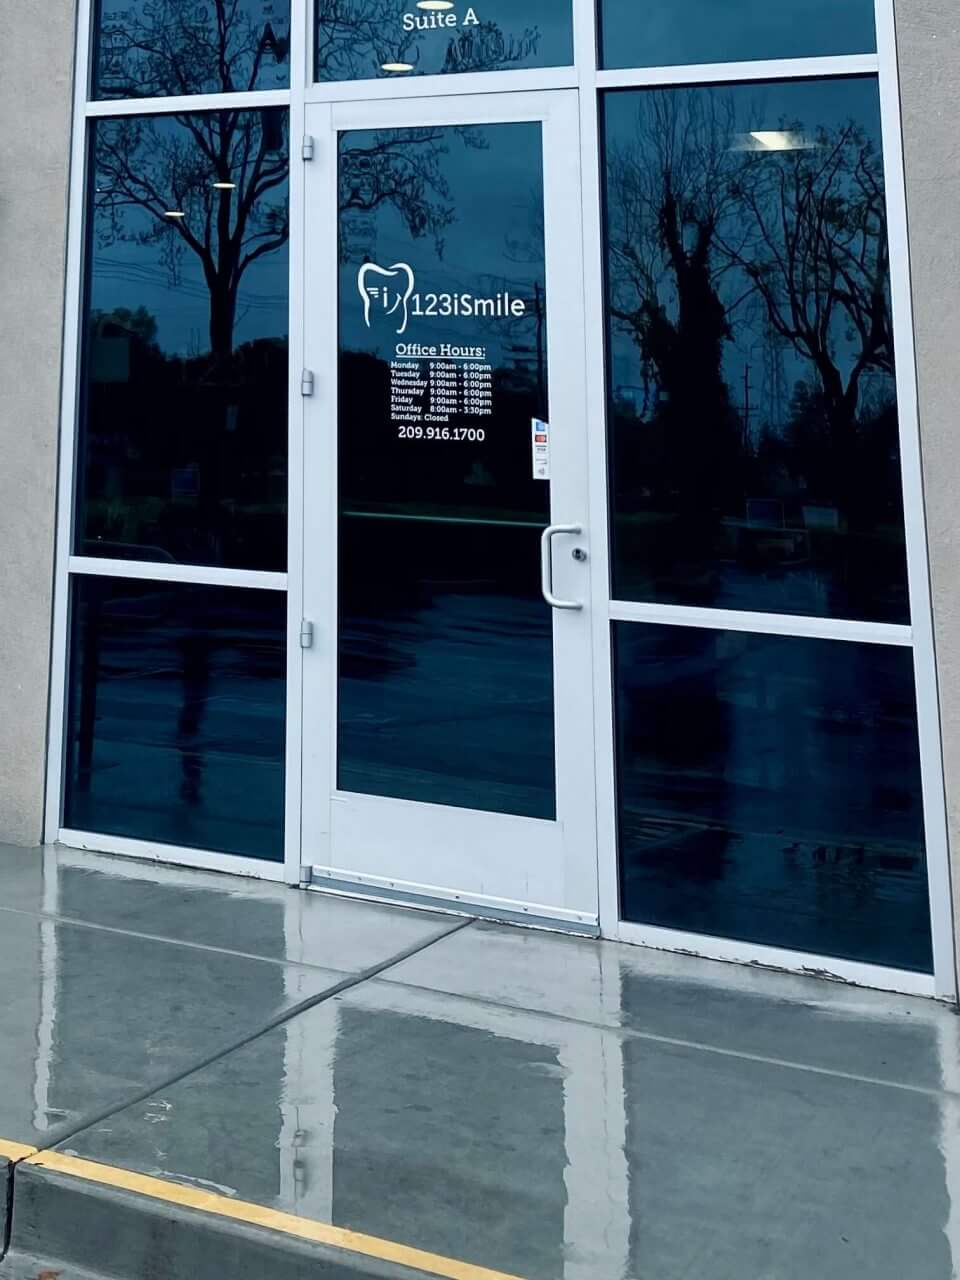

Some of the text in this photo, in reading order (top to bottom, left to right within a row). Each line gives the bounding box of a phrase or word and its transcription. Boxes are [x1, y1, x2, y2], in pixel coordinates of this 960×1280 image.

[403, 7, 480, 31] Suite A
[411, 292, 526, 317] 123iSmile
[396, 343, 486, 357] Office Hours:
[390, 361, 420, 371] Monday
[390, 370, 420, 379] Tuesday
[390, 378, 428, 388] Wednesday
[390, 387, 425, 396] Thursday
[391, 395, 414, 404] Friday
[390, 404, 423, 413] Saturday
[424, 413, 449, 422] Closed
[398, 425, 486, 442] 209.916.1700
